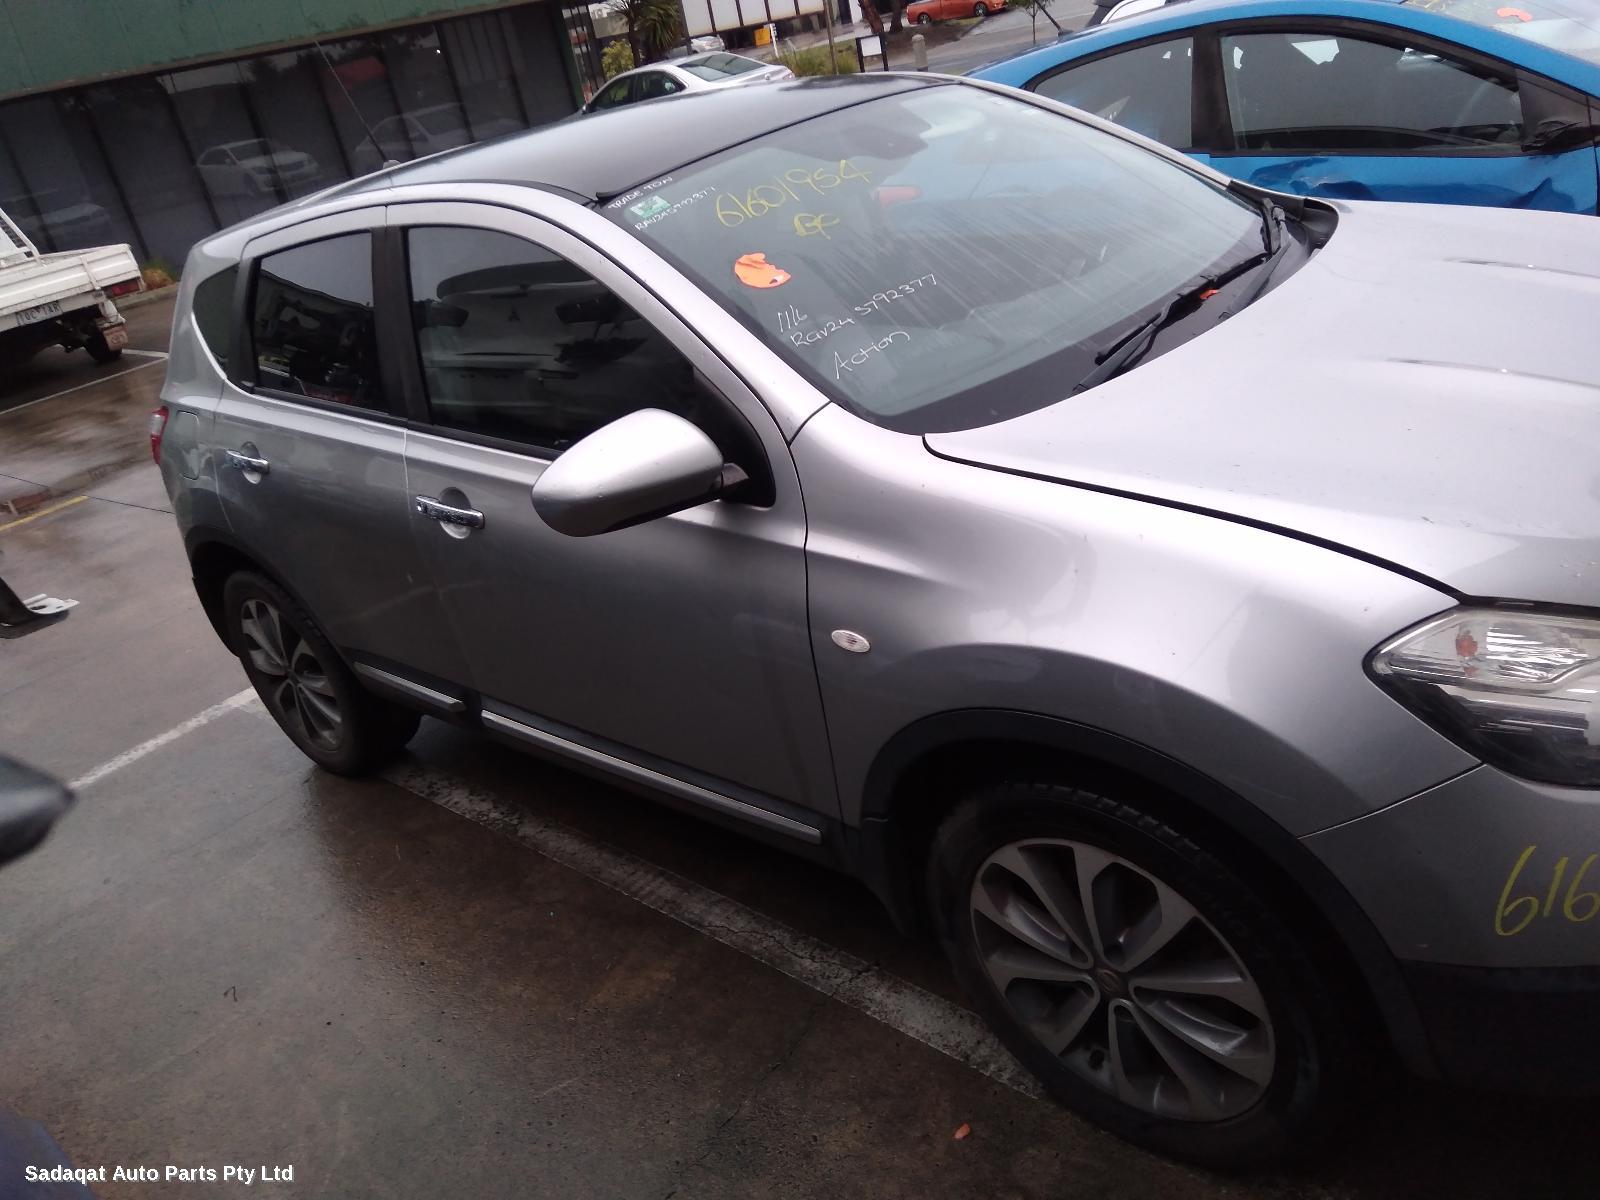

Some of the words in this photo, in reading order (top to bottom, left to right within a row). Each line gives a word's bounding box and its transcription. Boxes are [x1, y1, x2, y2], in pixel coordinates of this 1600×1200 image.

[715, 159, 873, 228] 61601954
[832, 331, 911, 380] Action
[1495, 845, 1600, 936] 616
